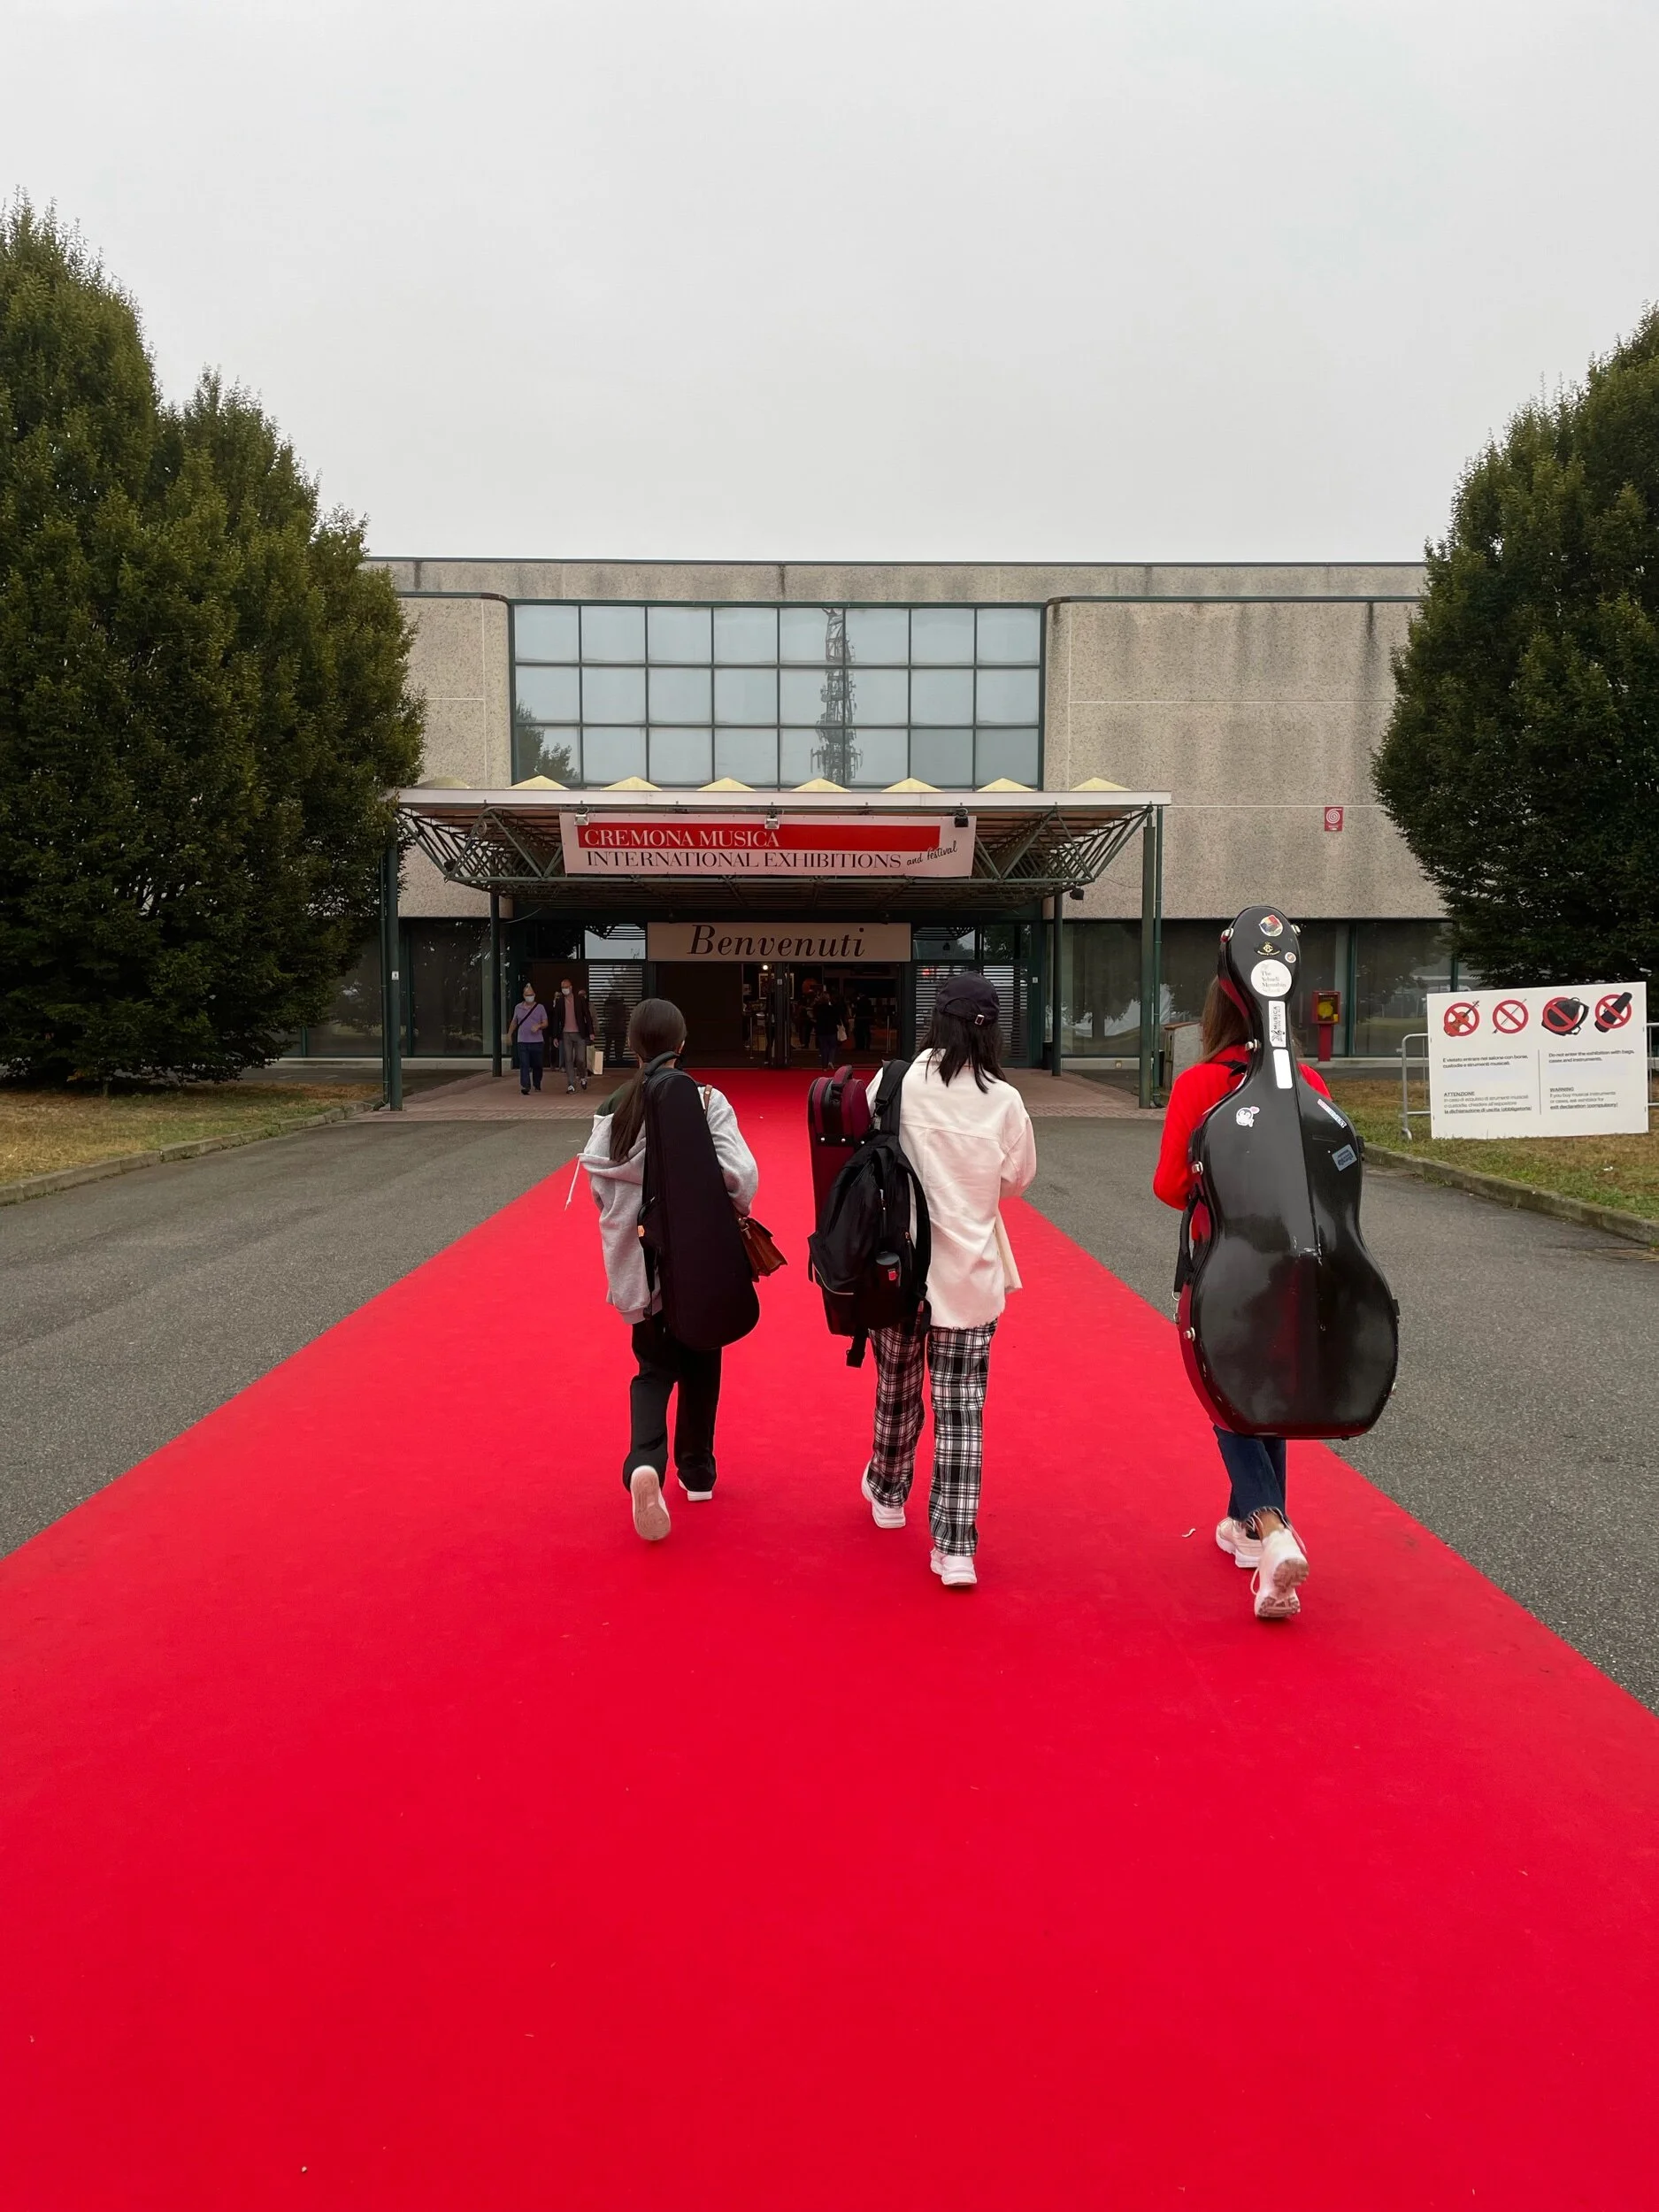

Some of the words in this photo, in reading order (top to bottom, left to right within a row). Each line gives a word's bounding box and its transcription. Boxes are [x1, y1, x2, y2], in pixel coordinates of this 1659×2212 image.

[584, 829, 694, 847] CREMONA
[699, 830, 780, 848] MUSICA
[587, 850, 759, 868] INTERNATIONAL
[764, 852, 901, 869] EXHIBITIONS
[906, 853, 924, 866] and
[926, 841, 958, 860] festival
[687, 924, 865, 957] Benvenuti
